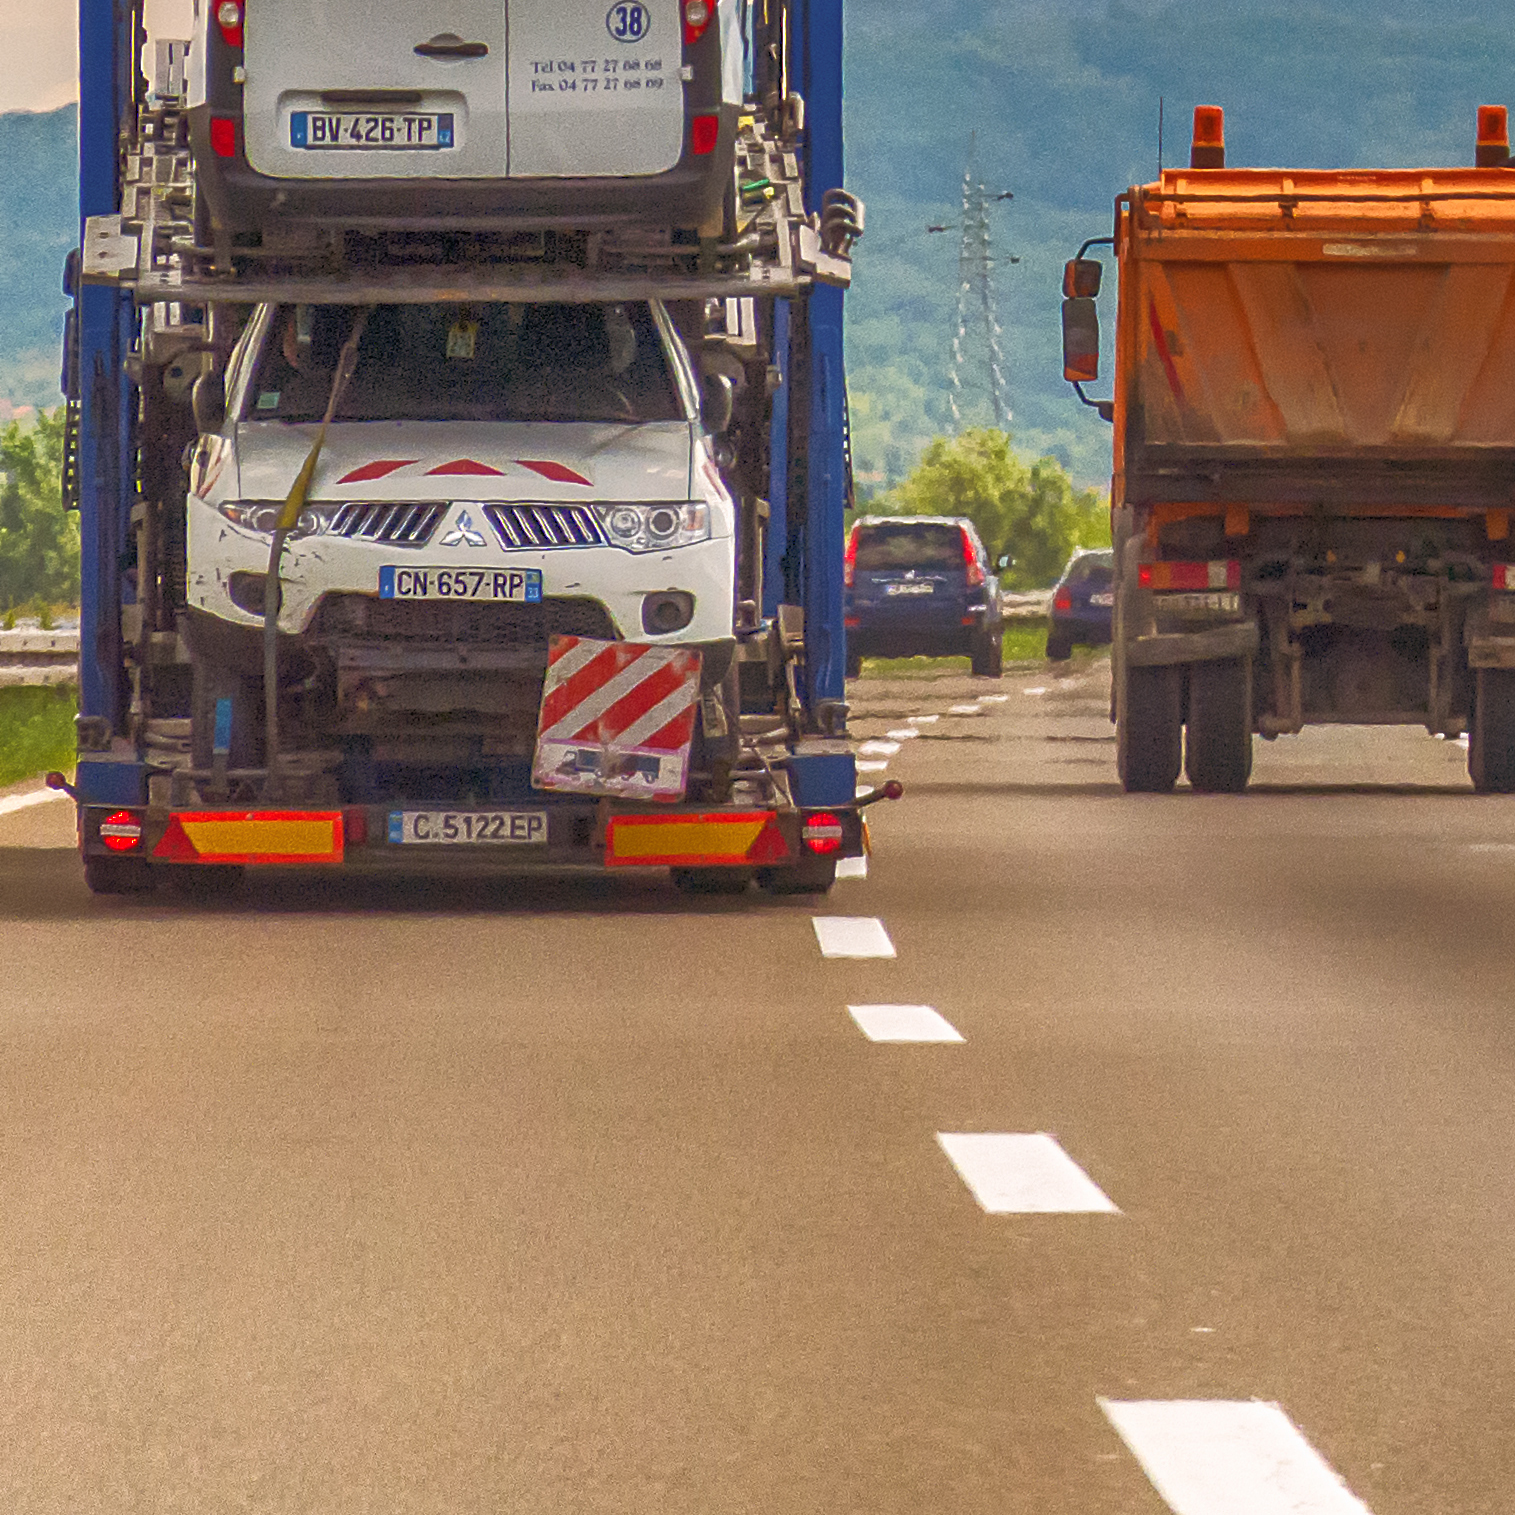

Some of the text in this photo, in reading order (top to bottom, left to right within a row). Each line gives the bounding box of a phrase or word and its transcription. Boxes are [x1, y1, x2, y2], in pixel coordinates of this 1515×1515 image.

[615, 6, 643, 37] 38
[580, 59, 597, 74] 77
[603, 58, 618, 74] 27
[530, 79, 555, 92] Fax
[559, 78, 577, 92] 04
[582, 78, 599, 92] 77
[603, 77, 619, 91] 27
[312, 116, 432, 143] BV-426-TP
[397, 570, 524, 599] CN-657-RP
